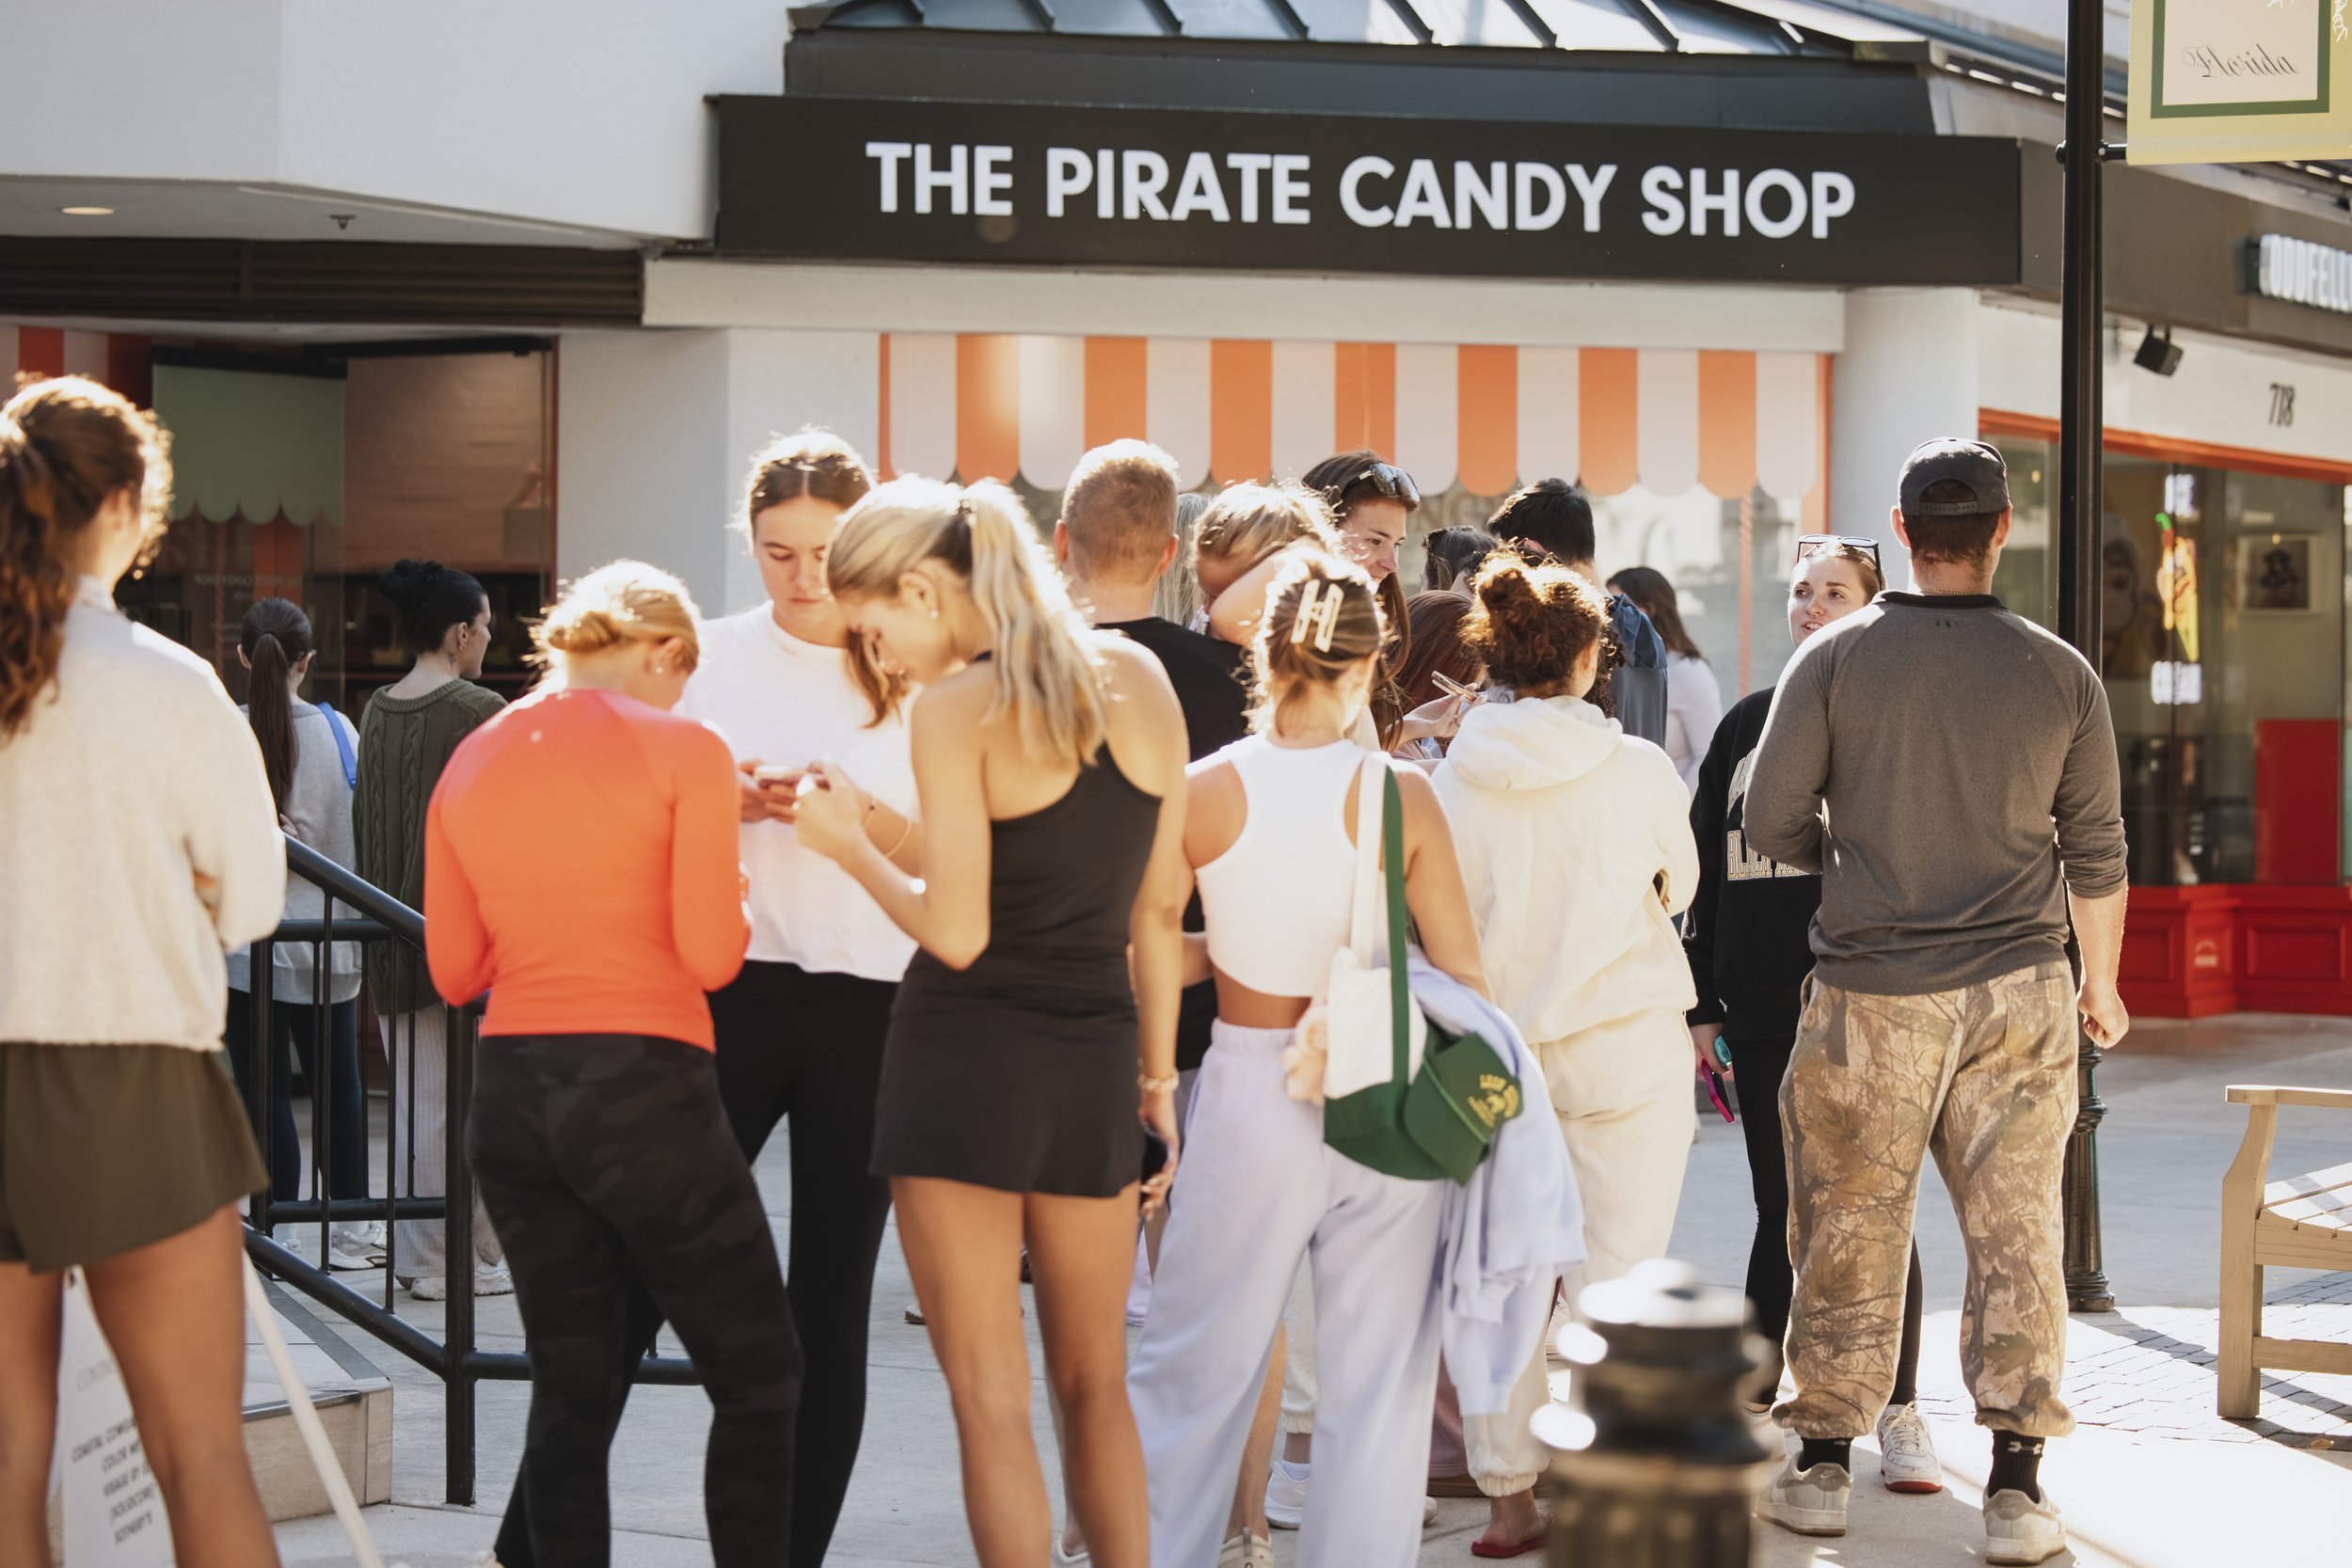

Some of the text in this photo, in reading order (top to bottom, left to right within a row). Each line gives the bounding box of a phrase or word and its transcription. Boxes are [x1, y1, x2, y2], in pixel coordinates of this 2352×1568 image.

[2182, 43, 2299, 78] Florida
[866, 143, 1854, 238] THE PIRATE CANDY SHOP
[2261, 234, 2352, 312] ODDFELL
[2268, 382, 2296, 426] 718
